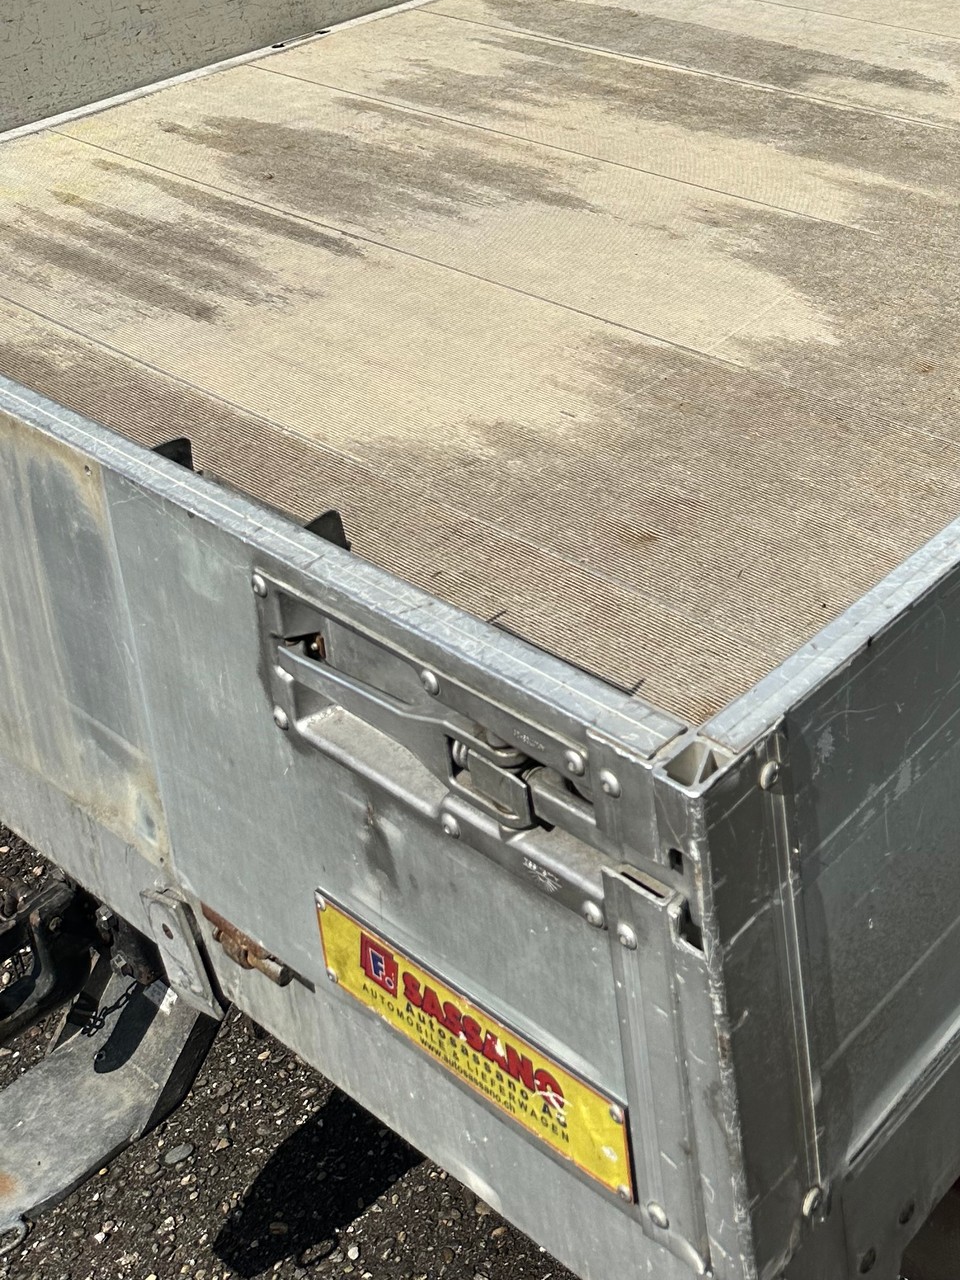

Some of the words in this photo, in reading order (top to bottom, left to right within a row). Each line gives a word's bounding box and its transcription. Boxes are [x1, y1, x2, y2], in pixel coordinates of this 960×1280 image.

[362, 982, 447, 1052] AUTOMOBILE
[466, 1059, 570, 1143] LIEFERWAGEN
[405, 1001, 529, 1101] Autosassano
